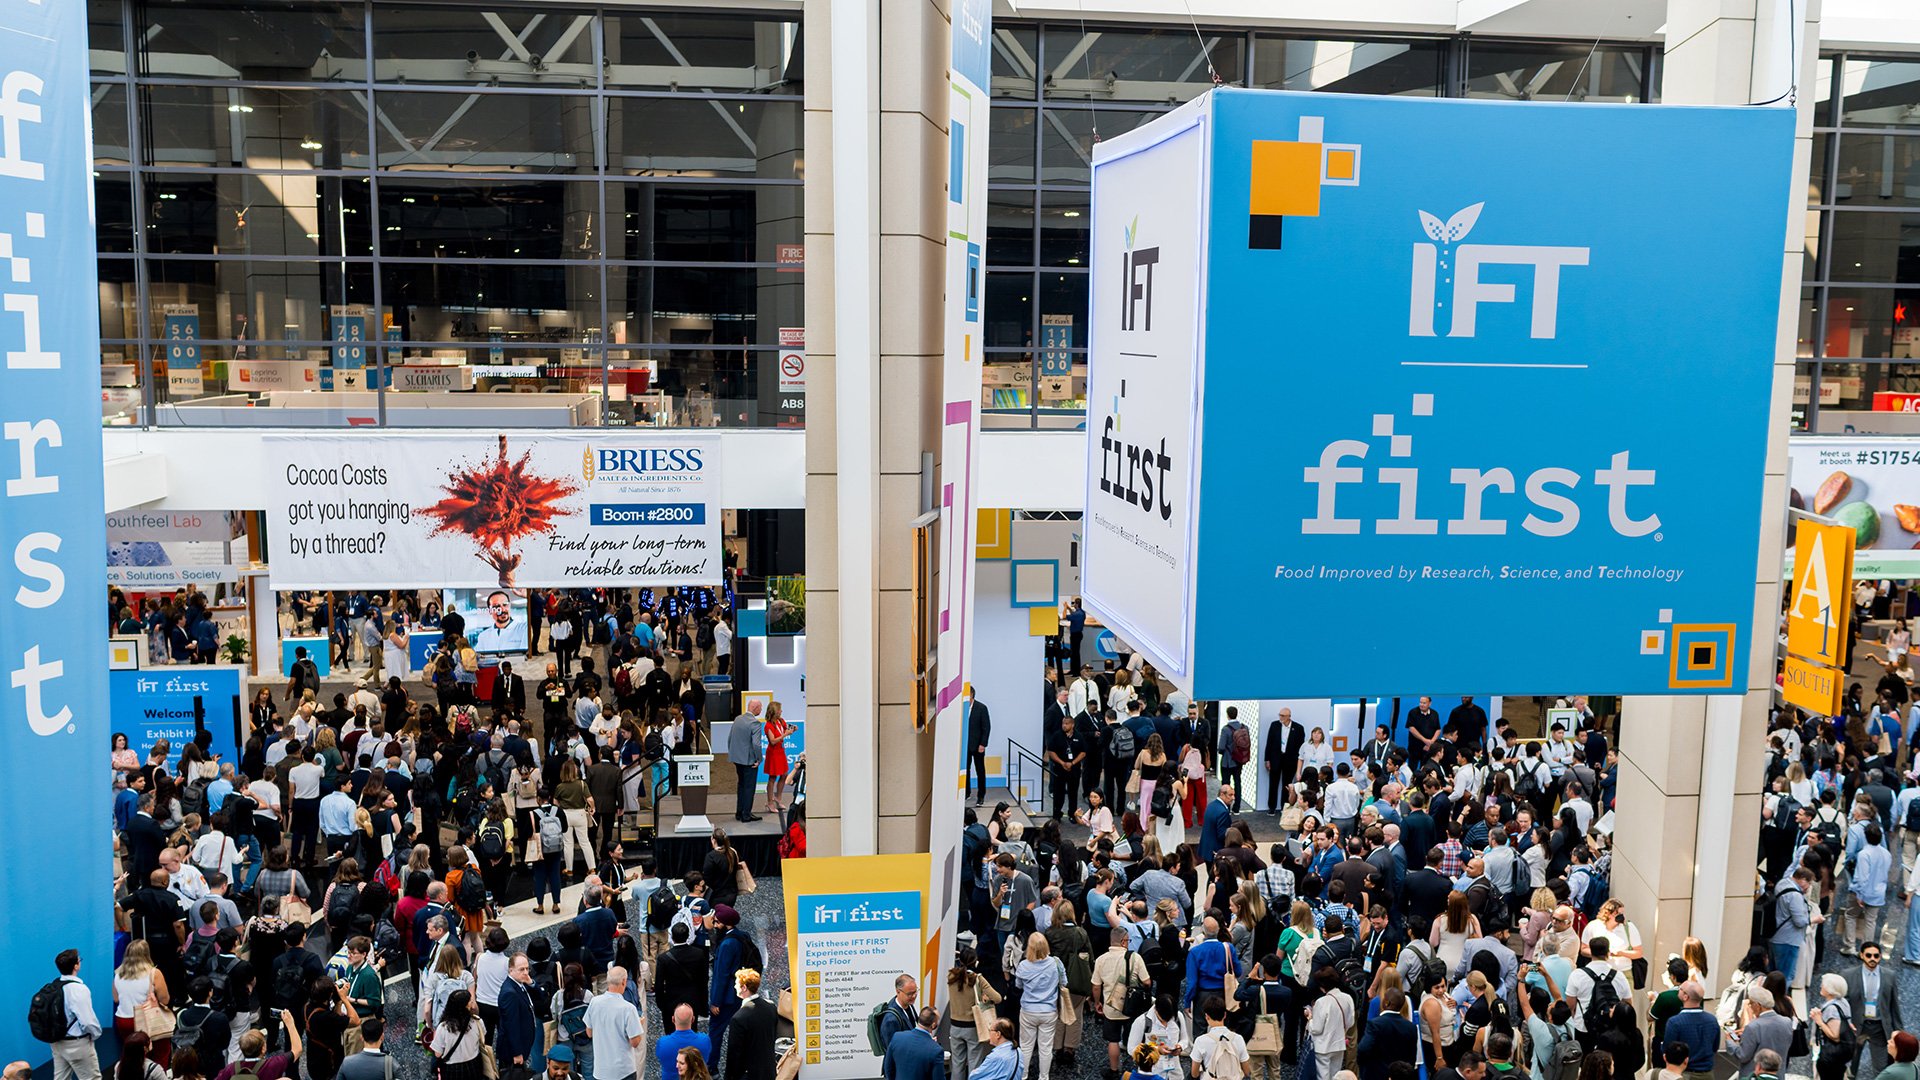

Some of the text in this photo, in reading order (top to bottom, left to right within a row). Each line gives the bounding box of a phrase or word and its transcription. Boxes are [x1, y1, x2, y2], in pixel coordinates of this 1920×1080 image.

[782, 248, 803, 258] FIRE
[1121, 247, 1160, 332] IFT
[1409, 240, 1590, 339] IFT
[782, 399, 804, 409] AB8
[598, 448, 703, 474] BRIESS
[286, 464, 388, 486] Cocoa Costs
[173, 514, 202, 528] Lab
[288, 498, 410, 526] got you hanging
[646, 508, 694, 521] #2800
[290, 531, 386, 559] by a thread?
[548, 533, 706, 558] Find your long-term
[564, 556, 708, 576] reliable solutions!
[1274, 565, 1684, 582] Food Improved by Research, Science, and Technology
[137, 676, 210, 692] IFT first
[1786, 666, 1831, 696] SOUTH
[146, 730, 183, 738] Exhibit
[814, 902, 904, 924] IFT first
[806, 949, 858, 958] Experiences
[806, 960, 828, 968] Expo
